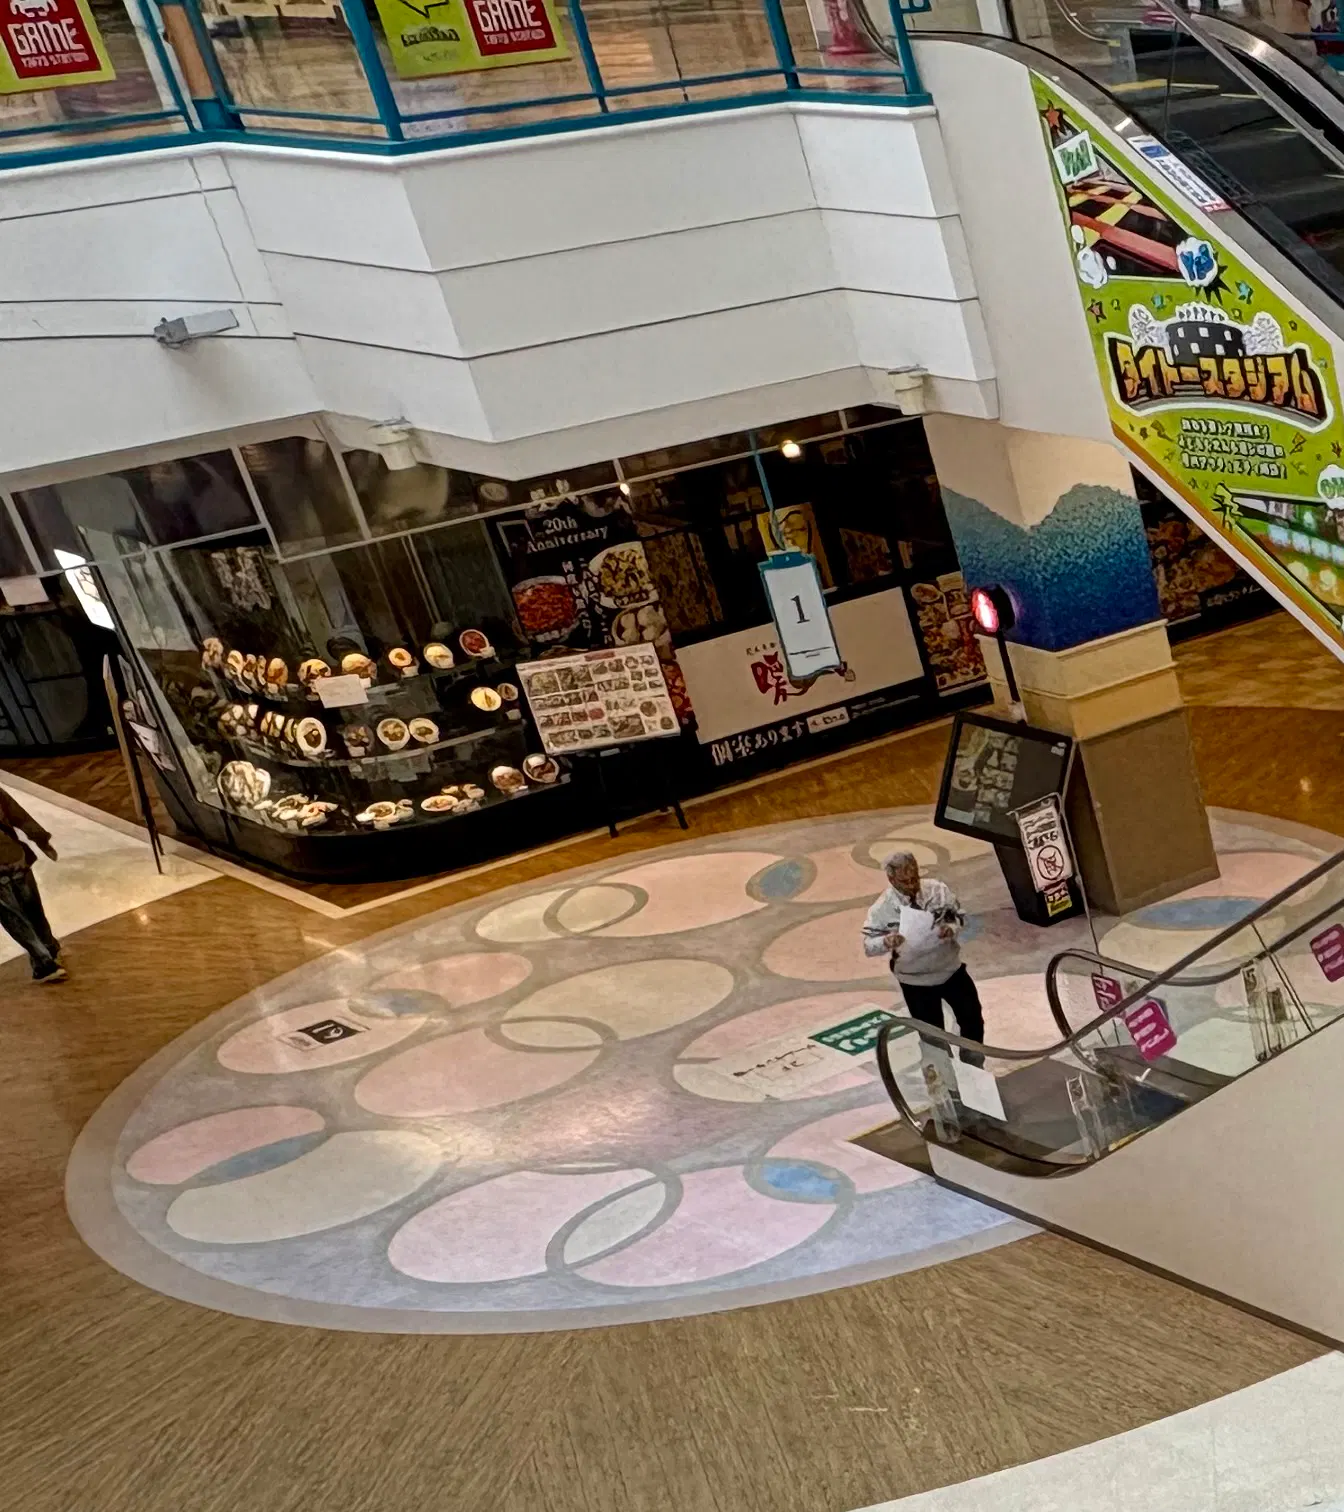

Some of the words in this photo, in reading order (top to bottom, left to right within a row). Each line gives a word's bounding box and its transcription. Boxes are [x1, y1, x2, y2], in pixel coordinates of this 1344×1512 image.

[473, 0, 542, 32] GAME
[7, 18, 85, 55] GAME
[1112, 338, 1324, 418] タイトースタジアム
[526, 525, 609, 553] Anniversary
[542, 516, 579, 535] 20th
[790, 594, 811, 623] 1
